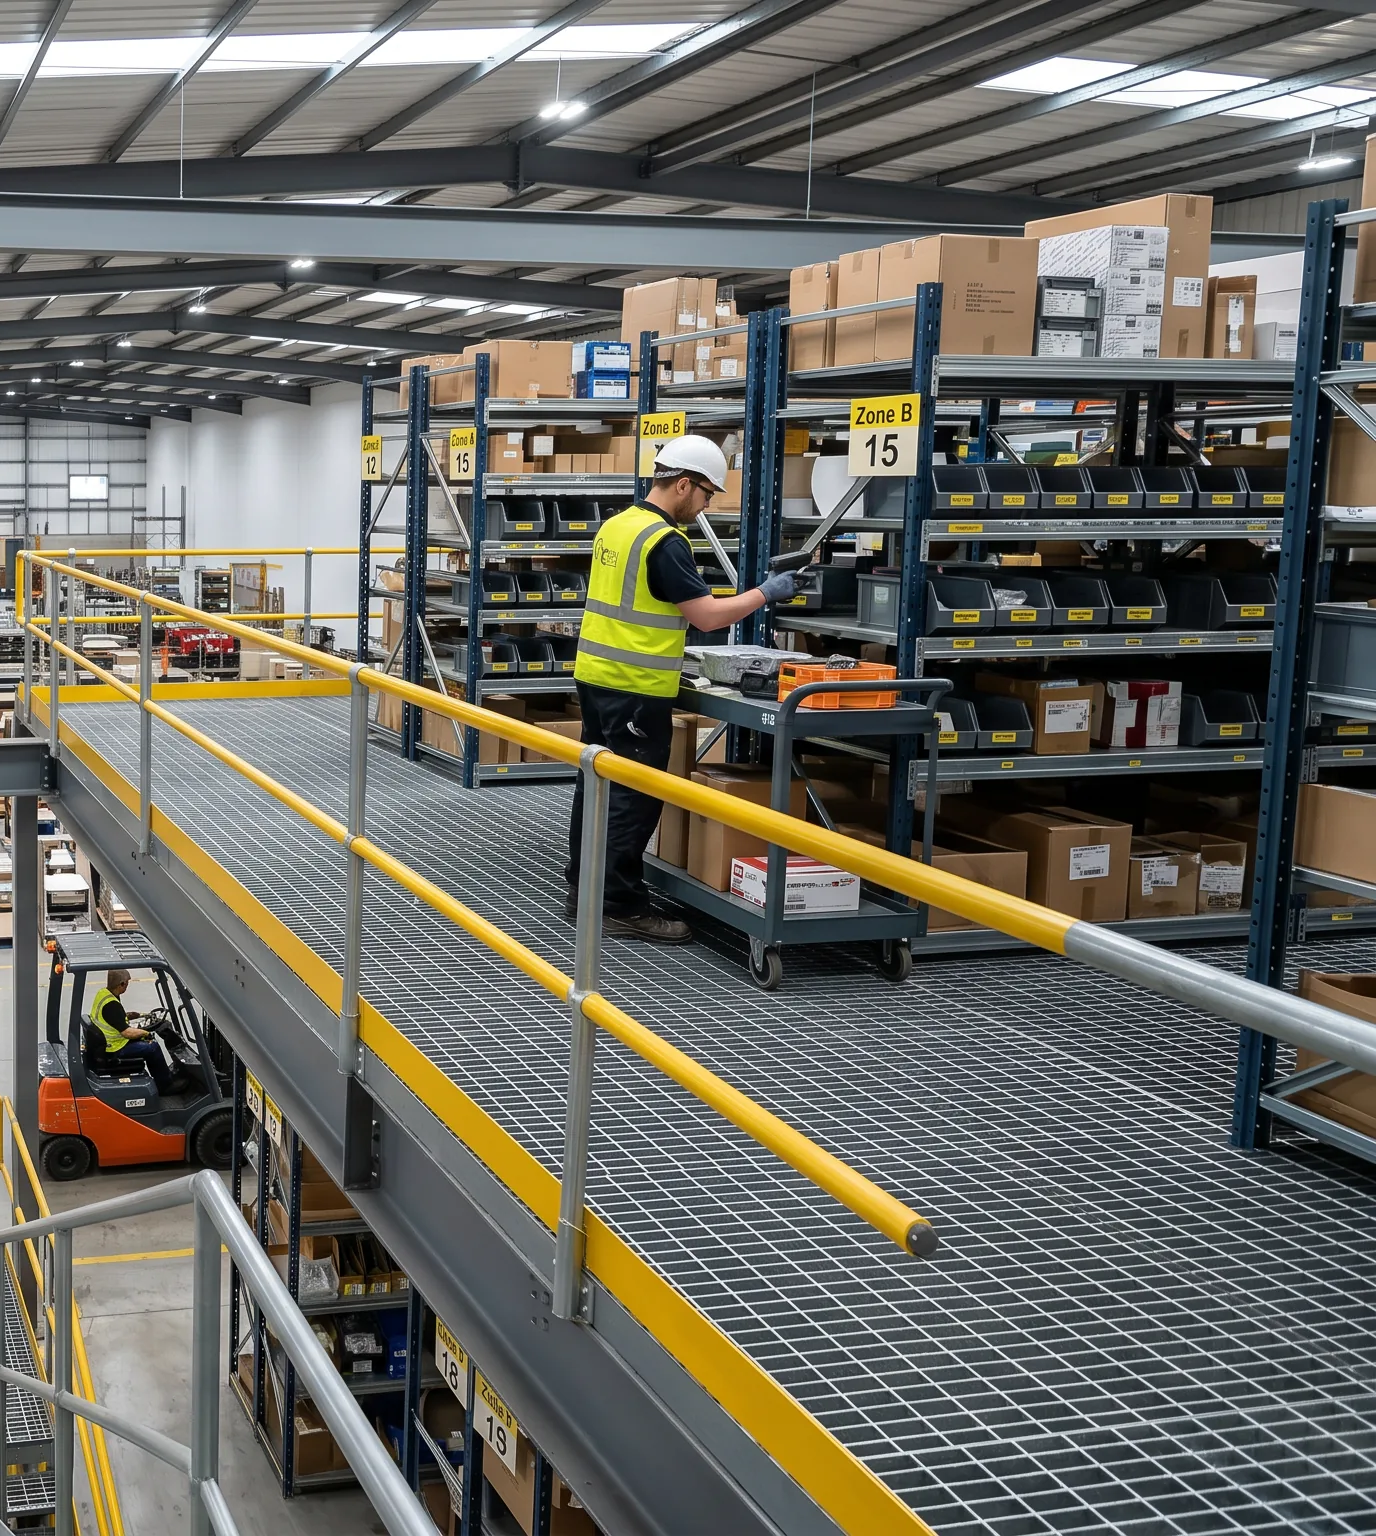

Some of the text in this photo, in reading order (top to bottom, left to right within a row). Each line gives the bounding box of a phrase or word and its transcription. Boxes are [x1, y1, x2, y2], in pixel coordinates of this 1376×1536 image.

[855, 402, 913, 425] Zone B
[643, 418, 680, 435] Zone B
[865, 433, 899, 467] 15
[366, 456, 376, 475] 12
[456, 452, 469, 474] 15
[442, 1350, 459, 1391] 18
